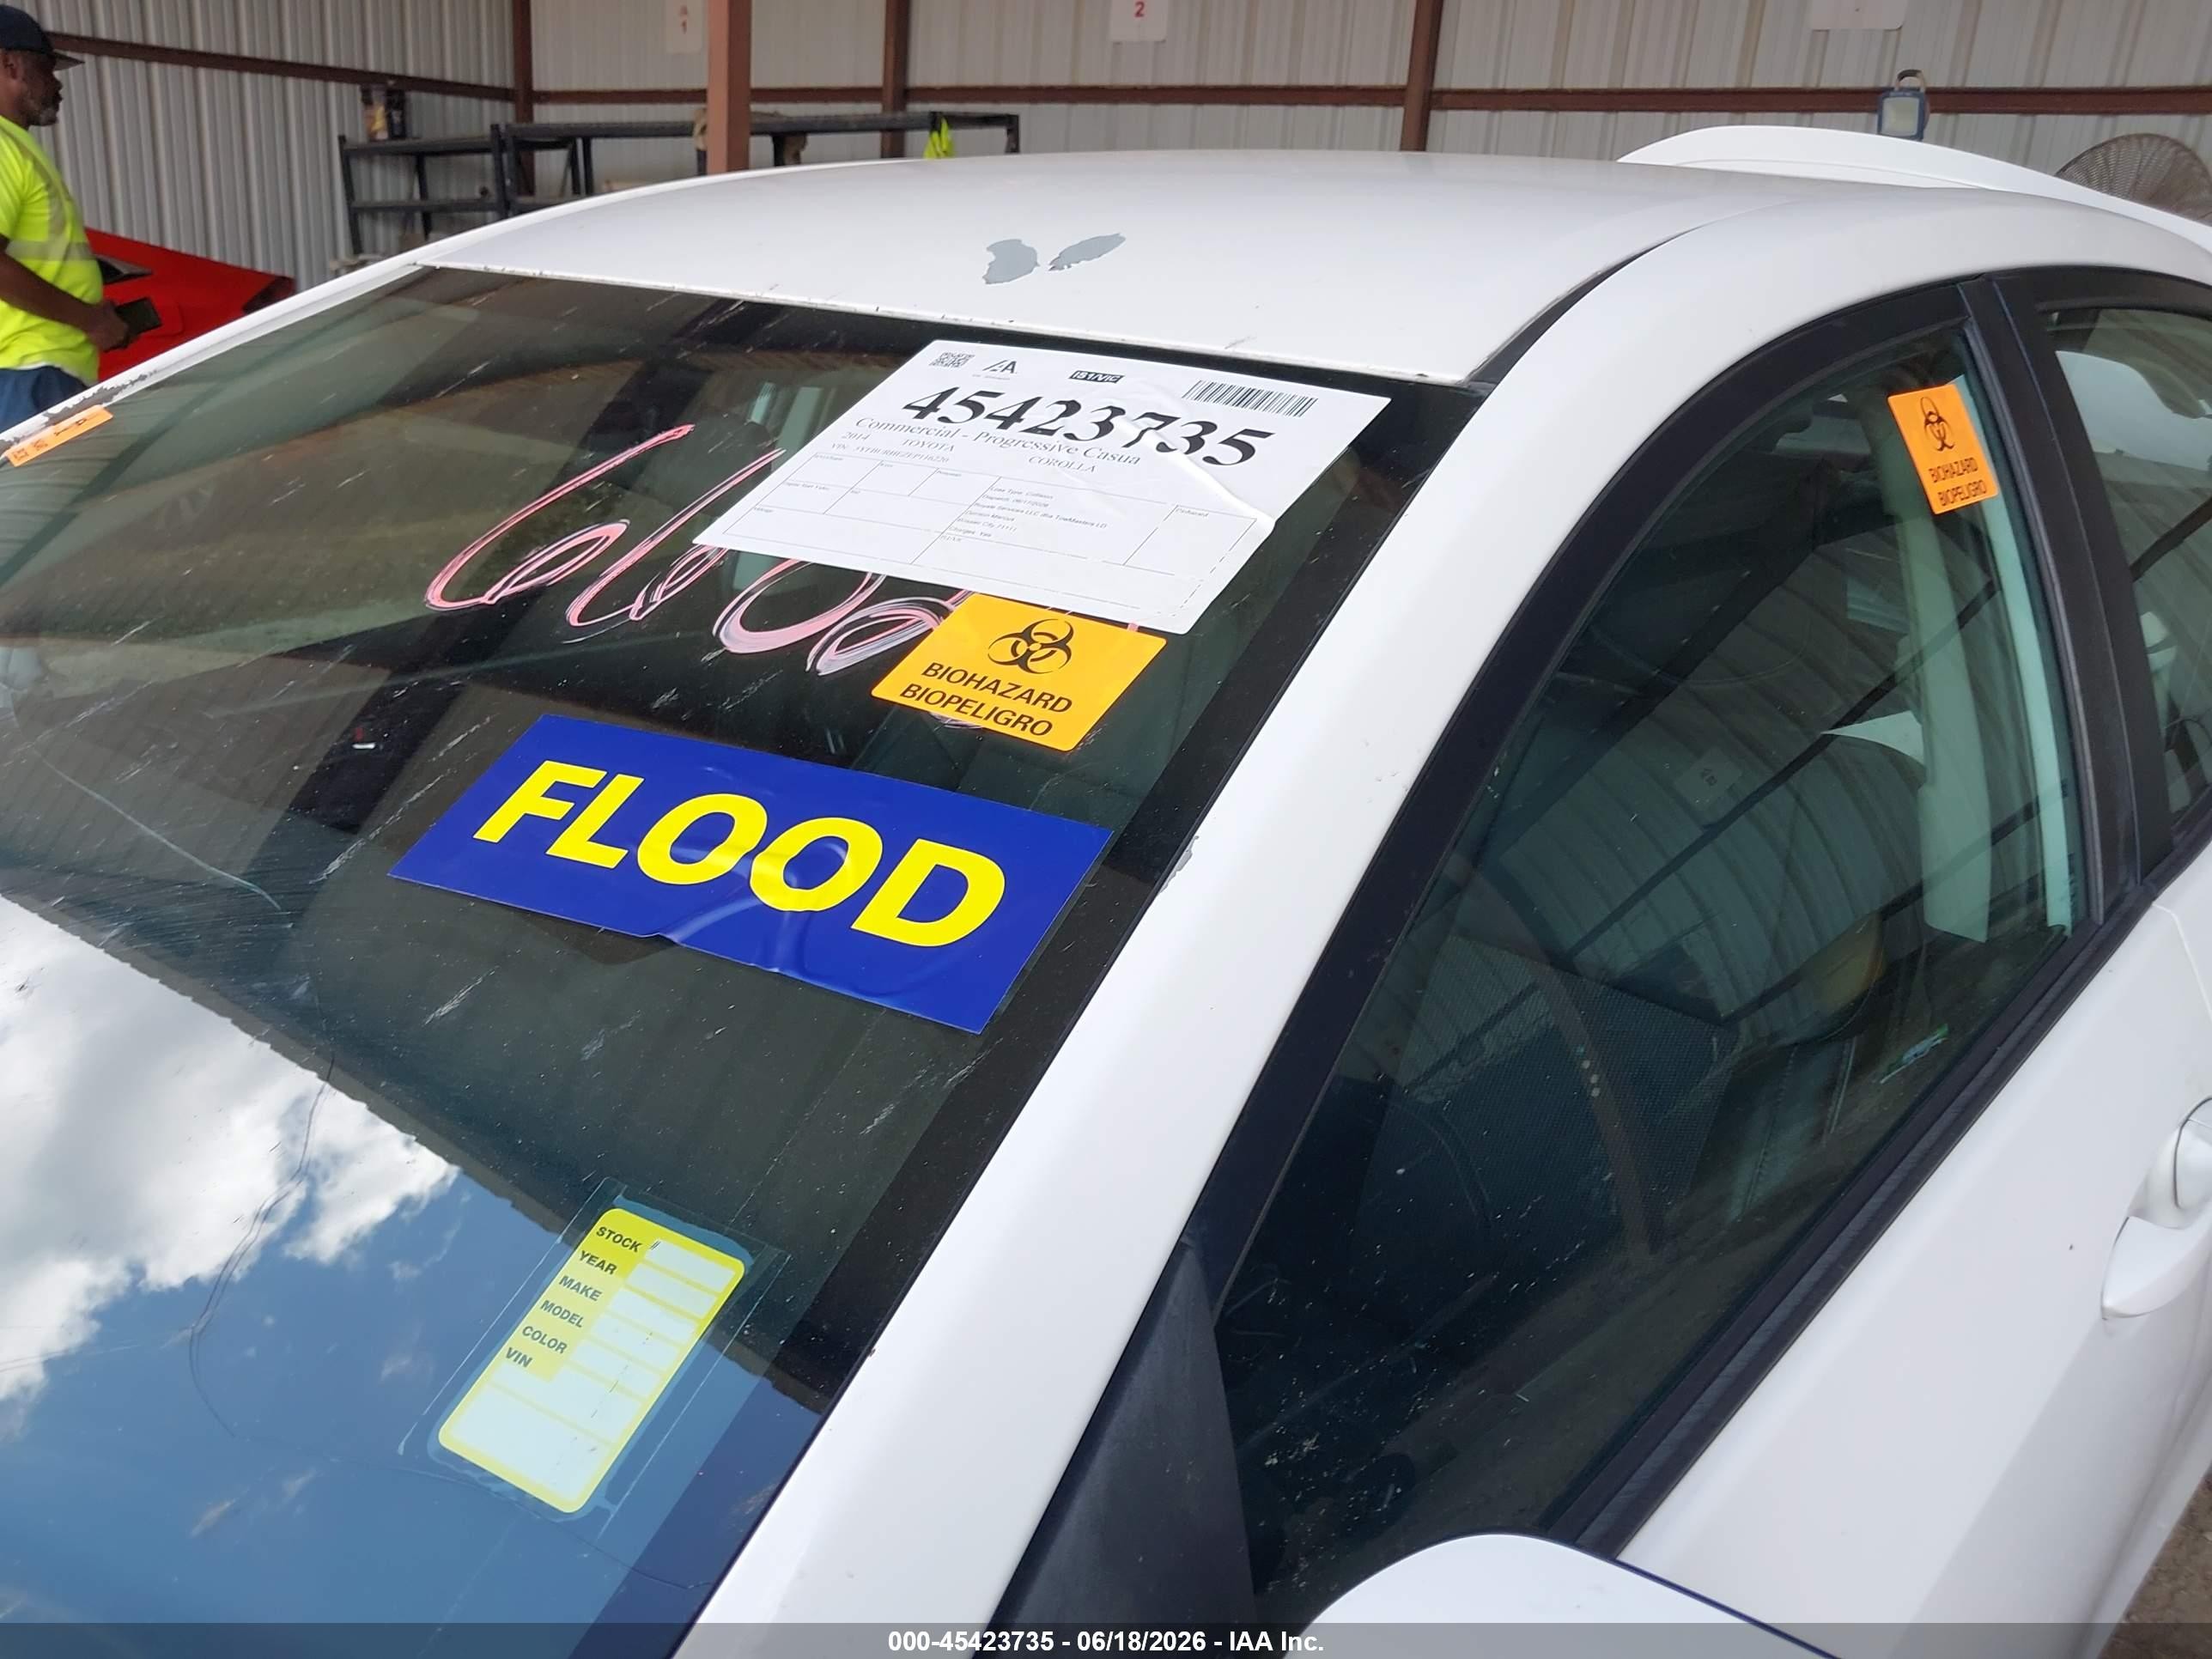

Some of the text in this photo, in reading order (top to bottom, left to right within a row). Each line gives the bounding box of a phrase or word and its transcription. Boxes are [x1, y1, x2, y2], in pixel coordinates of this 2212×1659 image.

[1134, 1, 1146, 18] 2
[856, 417, 960, 439] Commercial
[973, 431, 1079, 454] Progressive
[1083, 446, 1141, 465] Casua
[902, 386, 1275, 467] 45423735
[842, 431, 1097, 473] 2014 TOYOTA COROLLA
[1928, 456, 1979, 483] BIOHAZARD
[1937, 479, 1988, 507] BIOPELIGRO
[921, 661, 1073, 714] BIOHAZARD
[899, 683, 1053, 737] BIOPELIGRO
[473, 760, 1006, 947] FLOOD
[596, 1225, 642, 1253] STOCK
[578, 1250, 617, 1275] YEAR
[558, 1276, 601, 1302] MAKE
[539, 1299, 584, 1328] MODEL
[521, 1325, 568, 1354] COLOR
[505, 1346, 533, 1368] VIN
